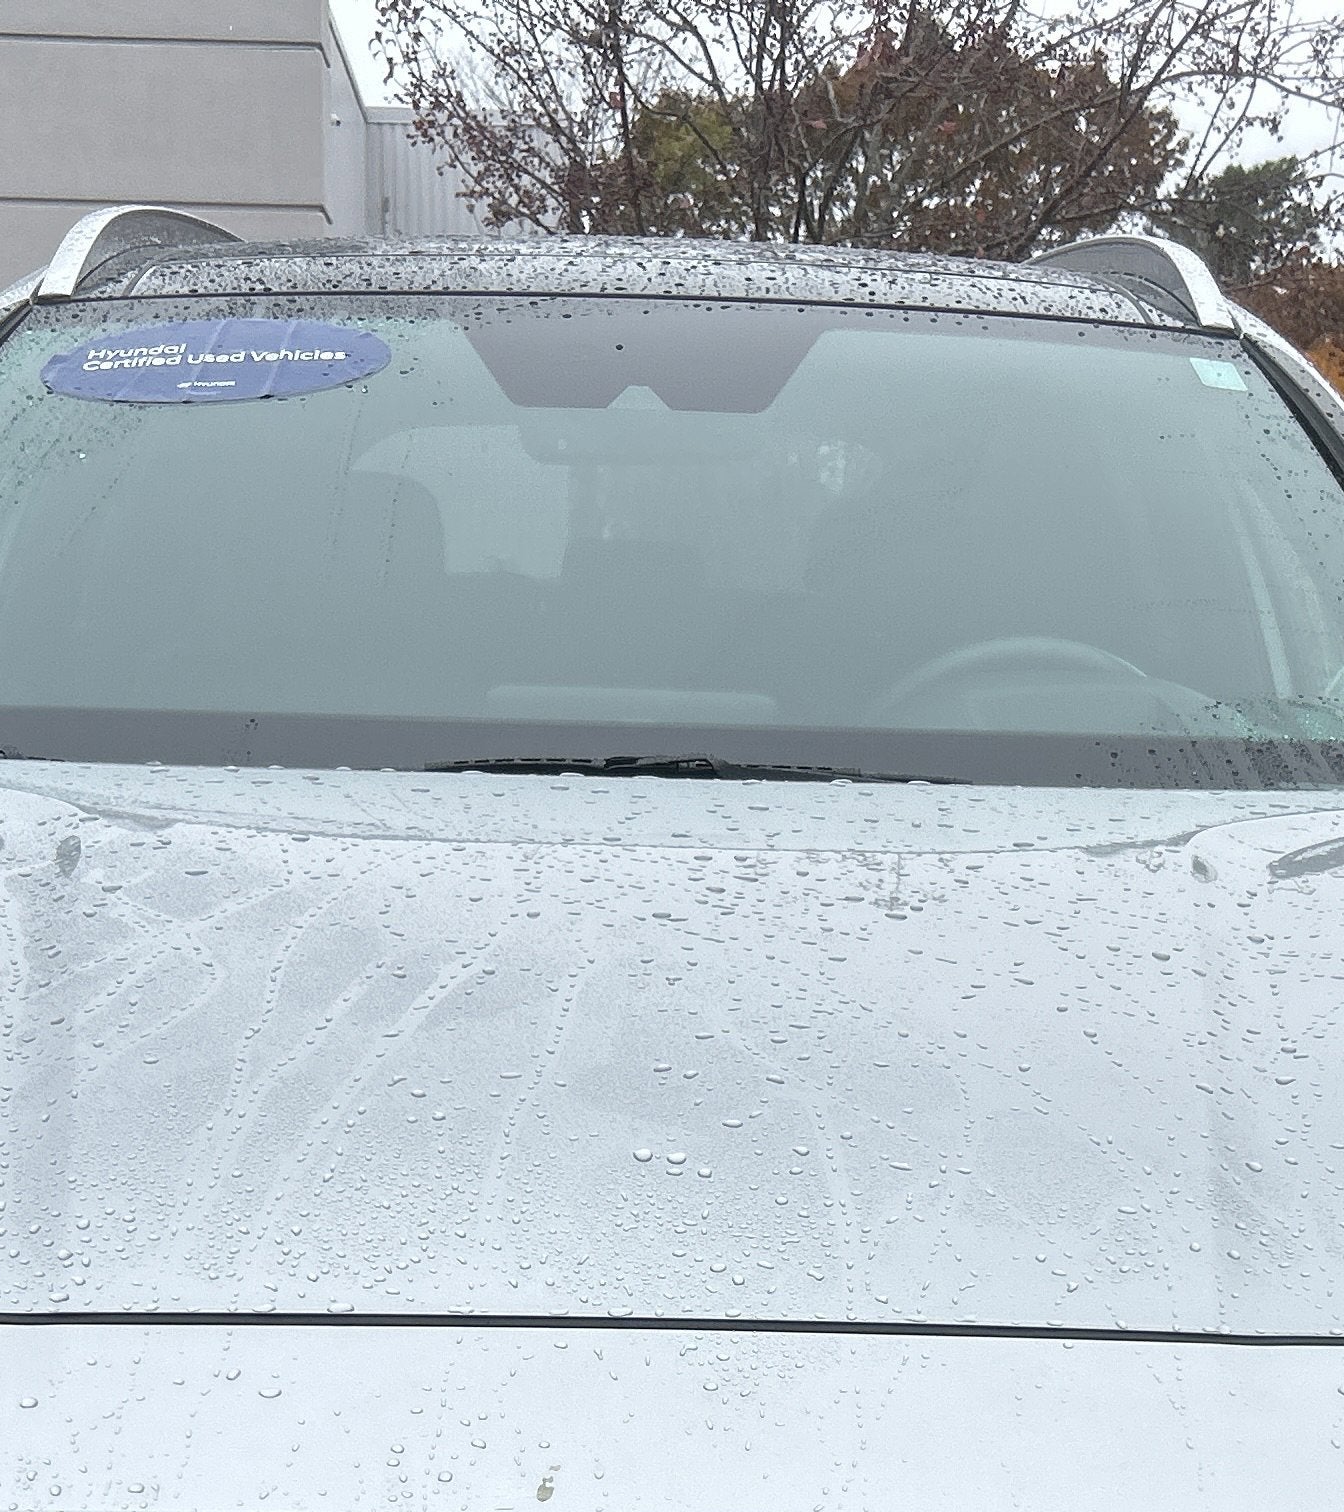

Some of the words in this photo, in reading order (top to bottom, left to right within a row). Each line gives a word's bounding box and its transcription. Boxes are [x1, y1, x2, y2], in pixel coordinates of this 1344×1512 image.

[81, 354, 183, 372] Certified
[186, 351, 246, 364] Used
[250, 349, 349, 362] Vehicles
[87, 343, 188, 361] Hyundai
